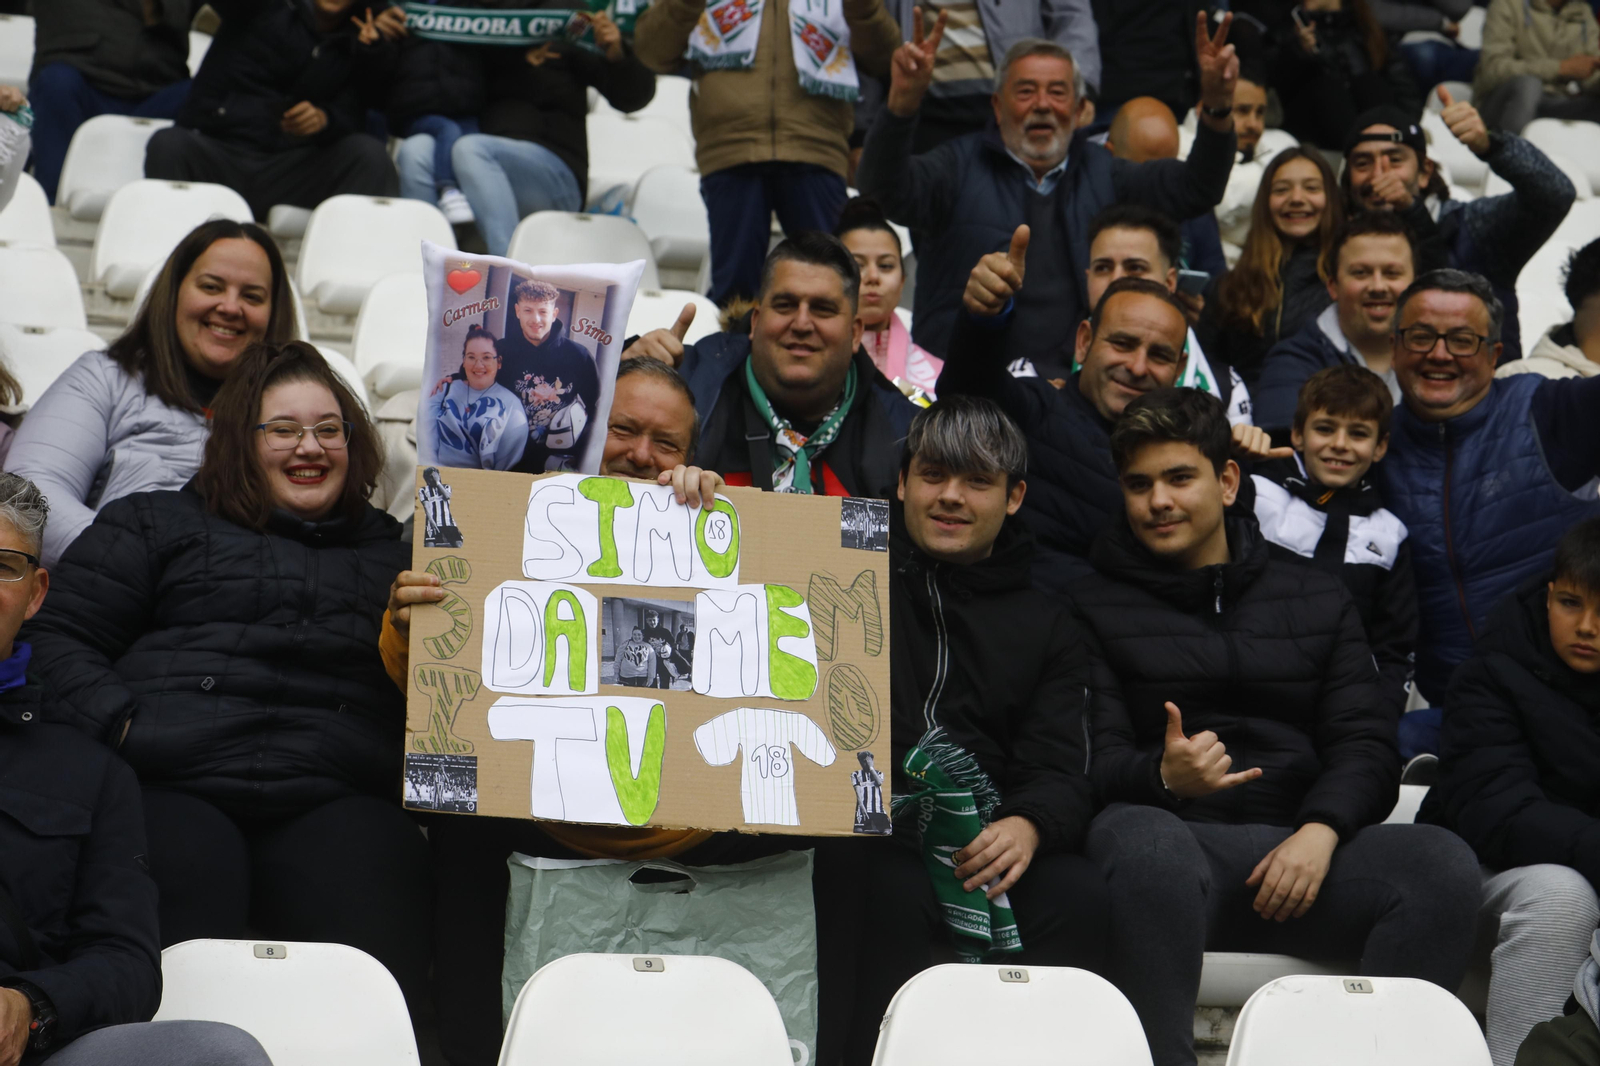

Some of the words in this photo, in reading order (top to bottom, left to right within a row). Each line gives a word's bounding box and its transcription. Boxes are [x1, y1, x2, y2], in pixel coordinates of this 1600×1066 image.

[442, 296, 500, 328] Carmen
[570, 317, 613, 347] Simo
[523, 476, 740, 582] SIMO
[708, 511, 728, 541] 18
[751, 744, 789, 779] 18
[266, 947, 275, 956] 8
[644, 960, 653, 969] 9
[1007, 970, 1022, 979] 10
[1349, 982, 1364, 991] 11
